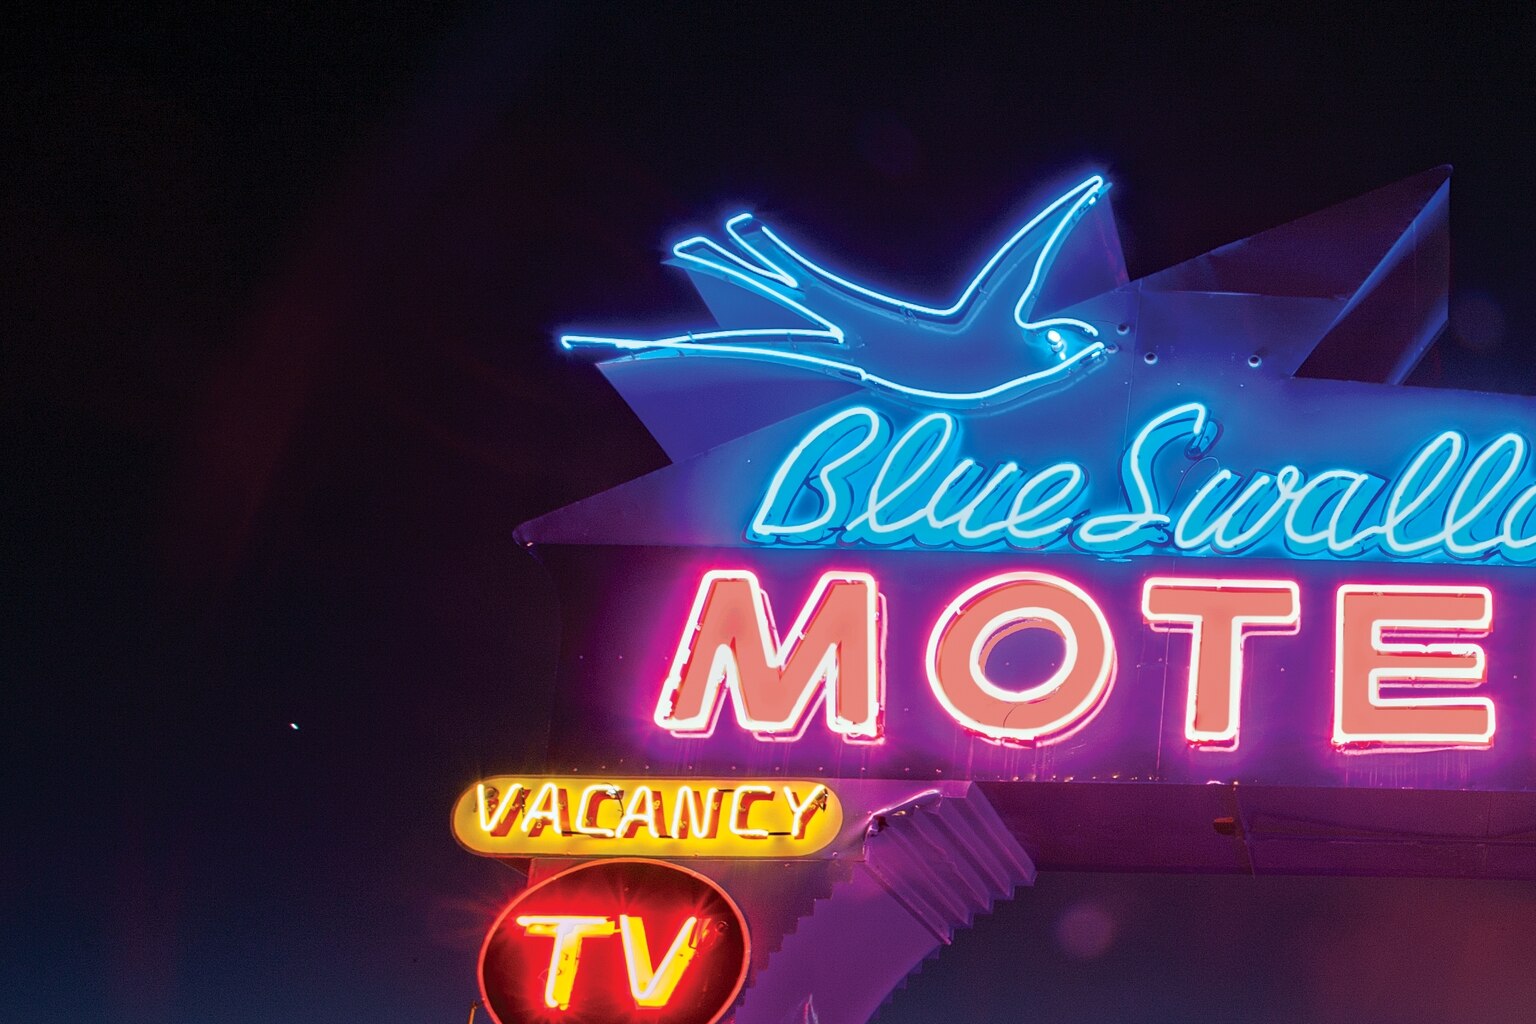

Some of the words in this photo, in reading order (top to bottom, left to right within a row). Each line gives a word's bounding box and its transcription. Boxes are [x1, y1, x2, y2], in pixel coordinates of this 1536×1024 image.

[747, 405, 1090, 548] Blue
[476, 782, 829, 840] VACANCY
[517, 914, 712, 1010] TV
